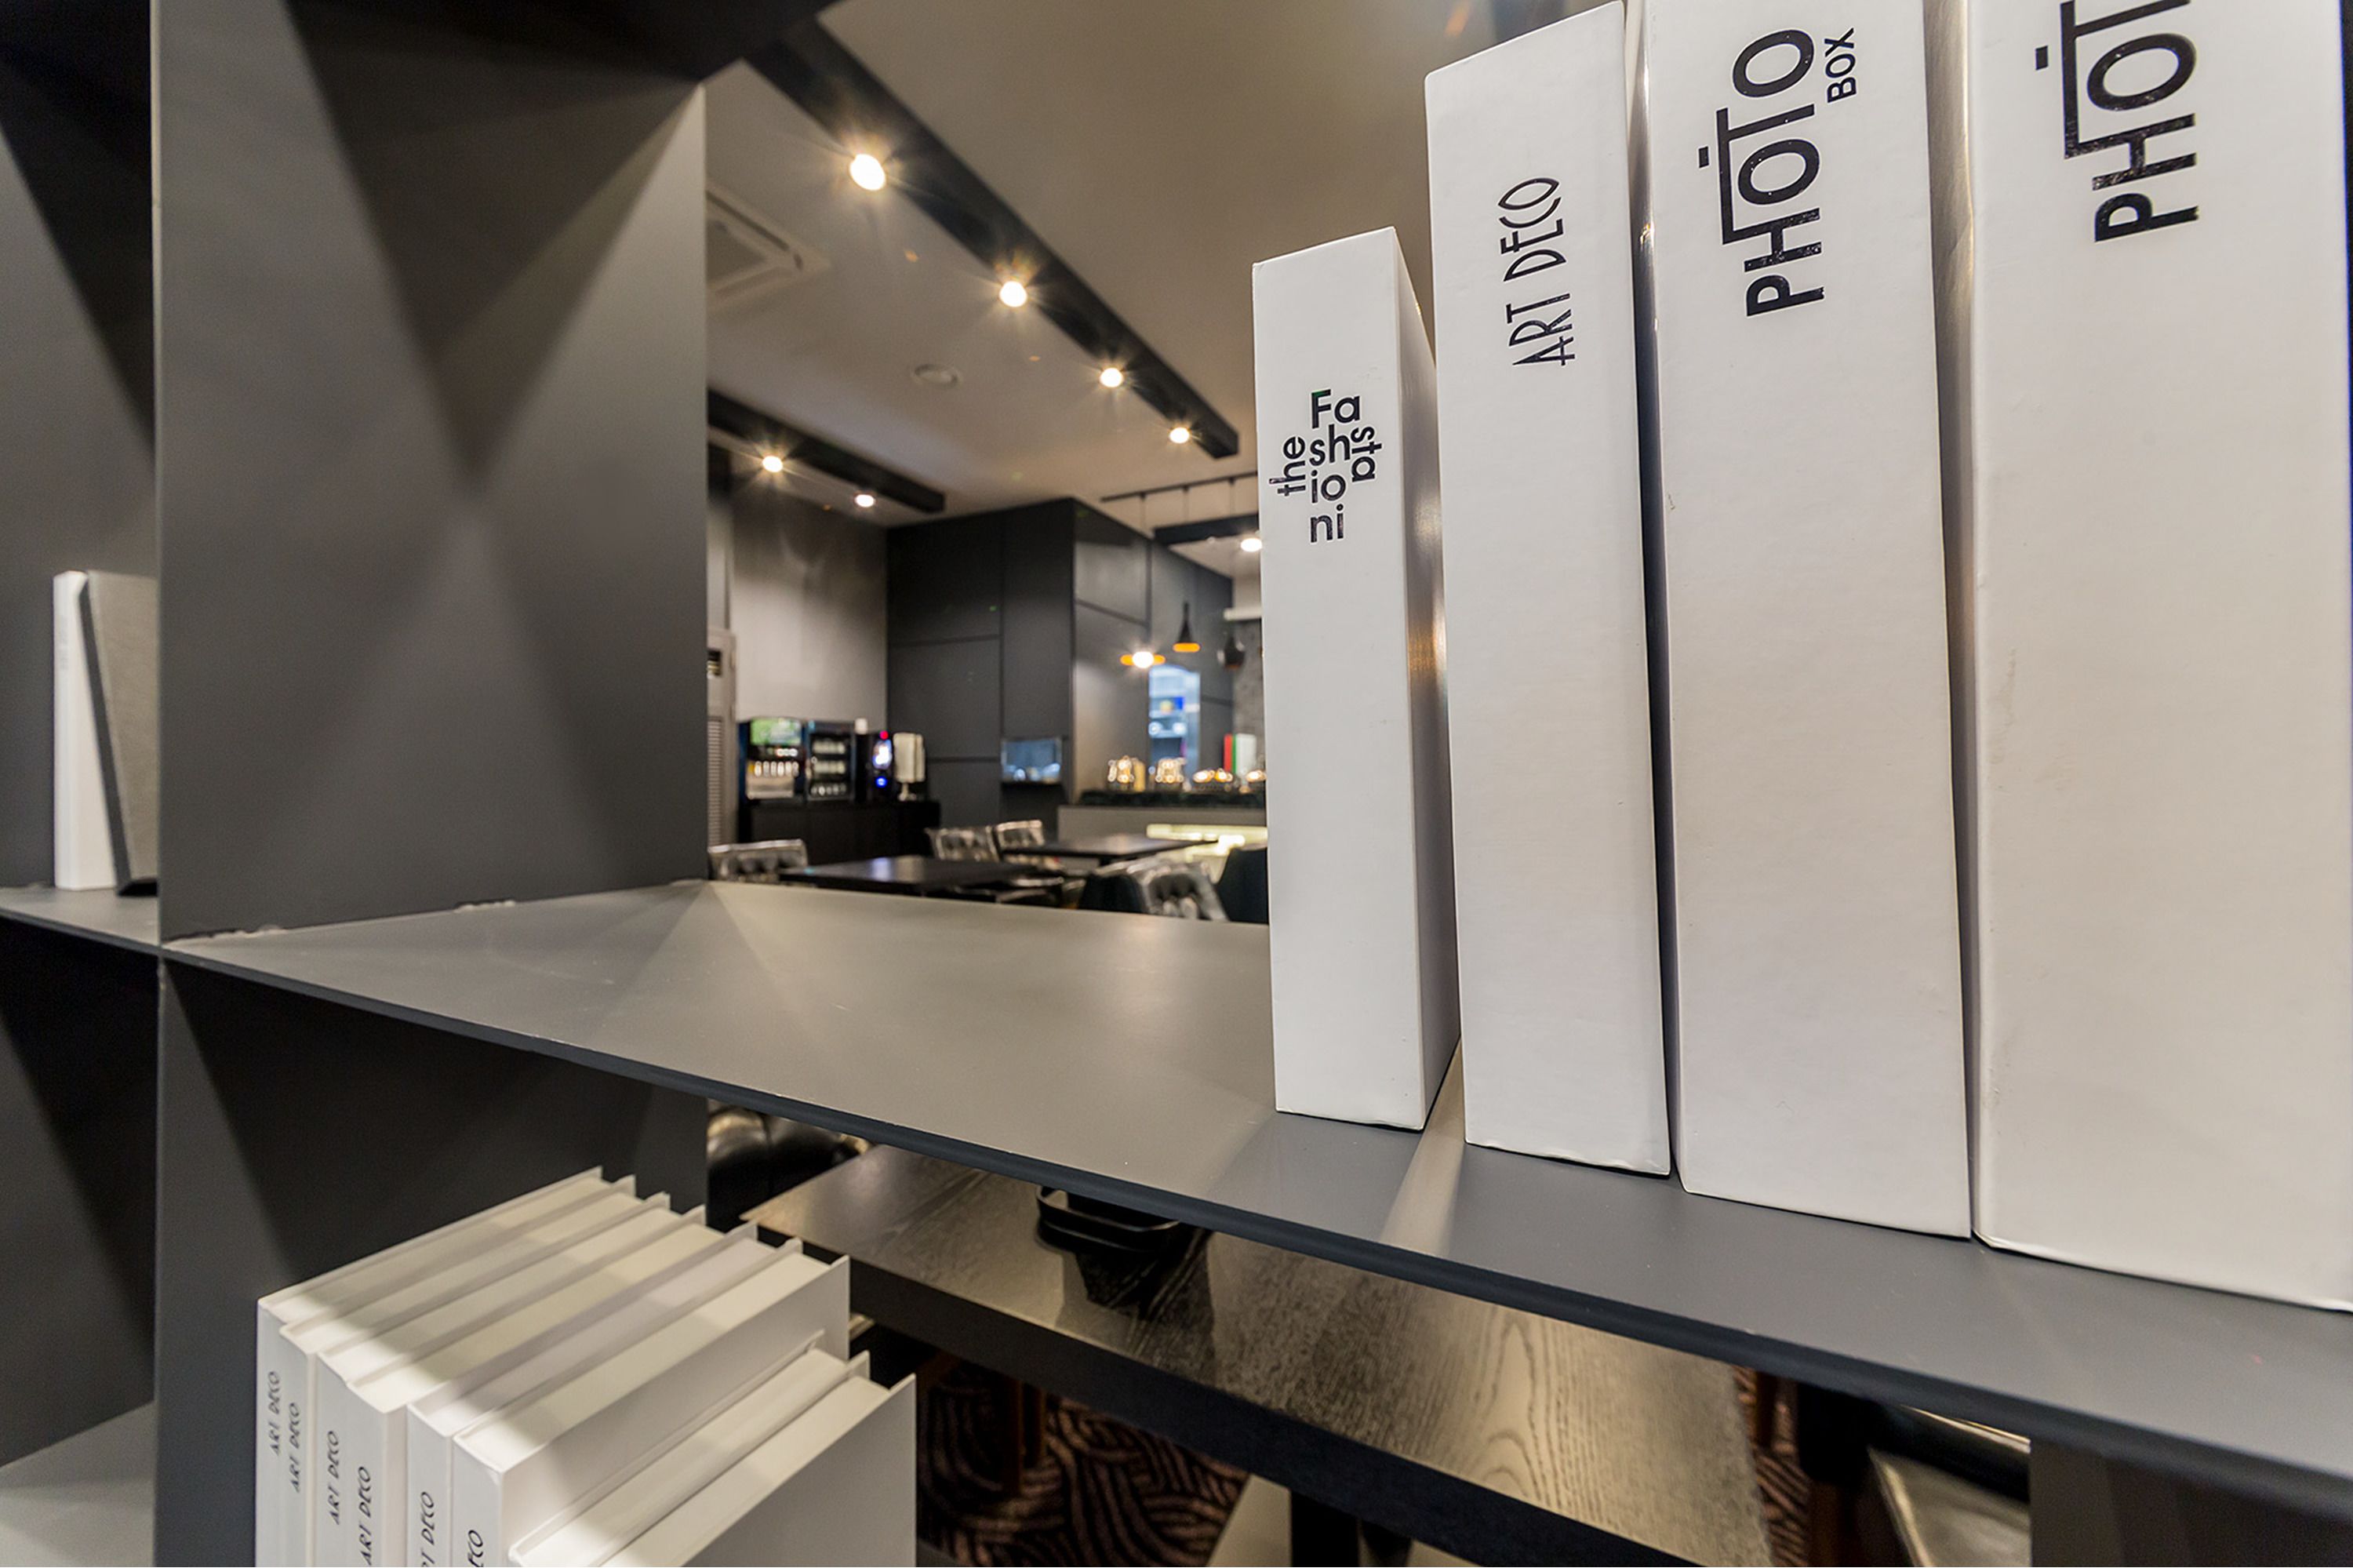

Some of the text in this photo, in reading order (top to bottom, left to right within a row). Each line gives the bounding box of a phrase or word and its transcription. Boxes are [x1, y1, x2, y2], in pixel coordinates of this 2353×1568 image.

[1824, 28, 1857, 103] BOX
[2035, 0, 2198, 242] PHOT
[1699, 30, 1824, 317] PHOTO
[1498, 177, 1576, 366] ART DECO
[1269, 436, 1307, 497] the
[267, 1371, 280, 1456] ART DECO
[289, 1402, 300, 1493] ART DECO
[327, 1430, 340, 1526] ART DECO
[358, 1466, 373, 1566] ART DECO
[420, 1491, 435, 1546] DECO
